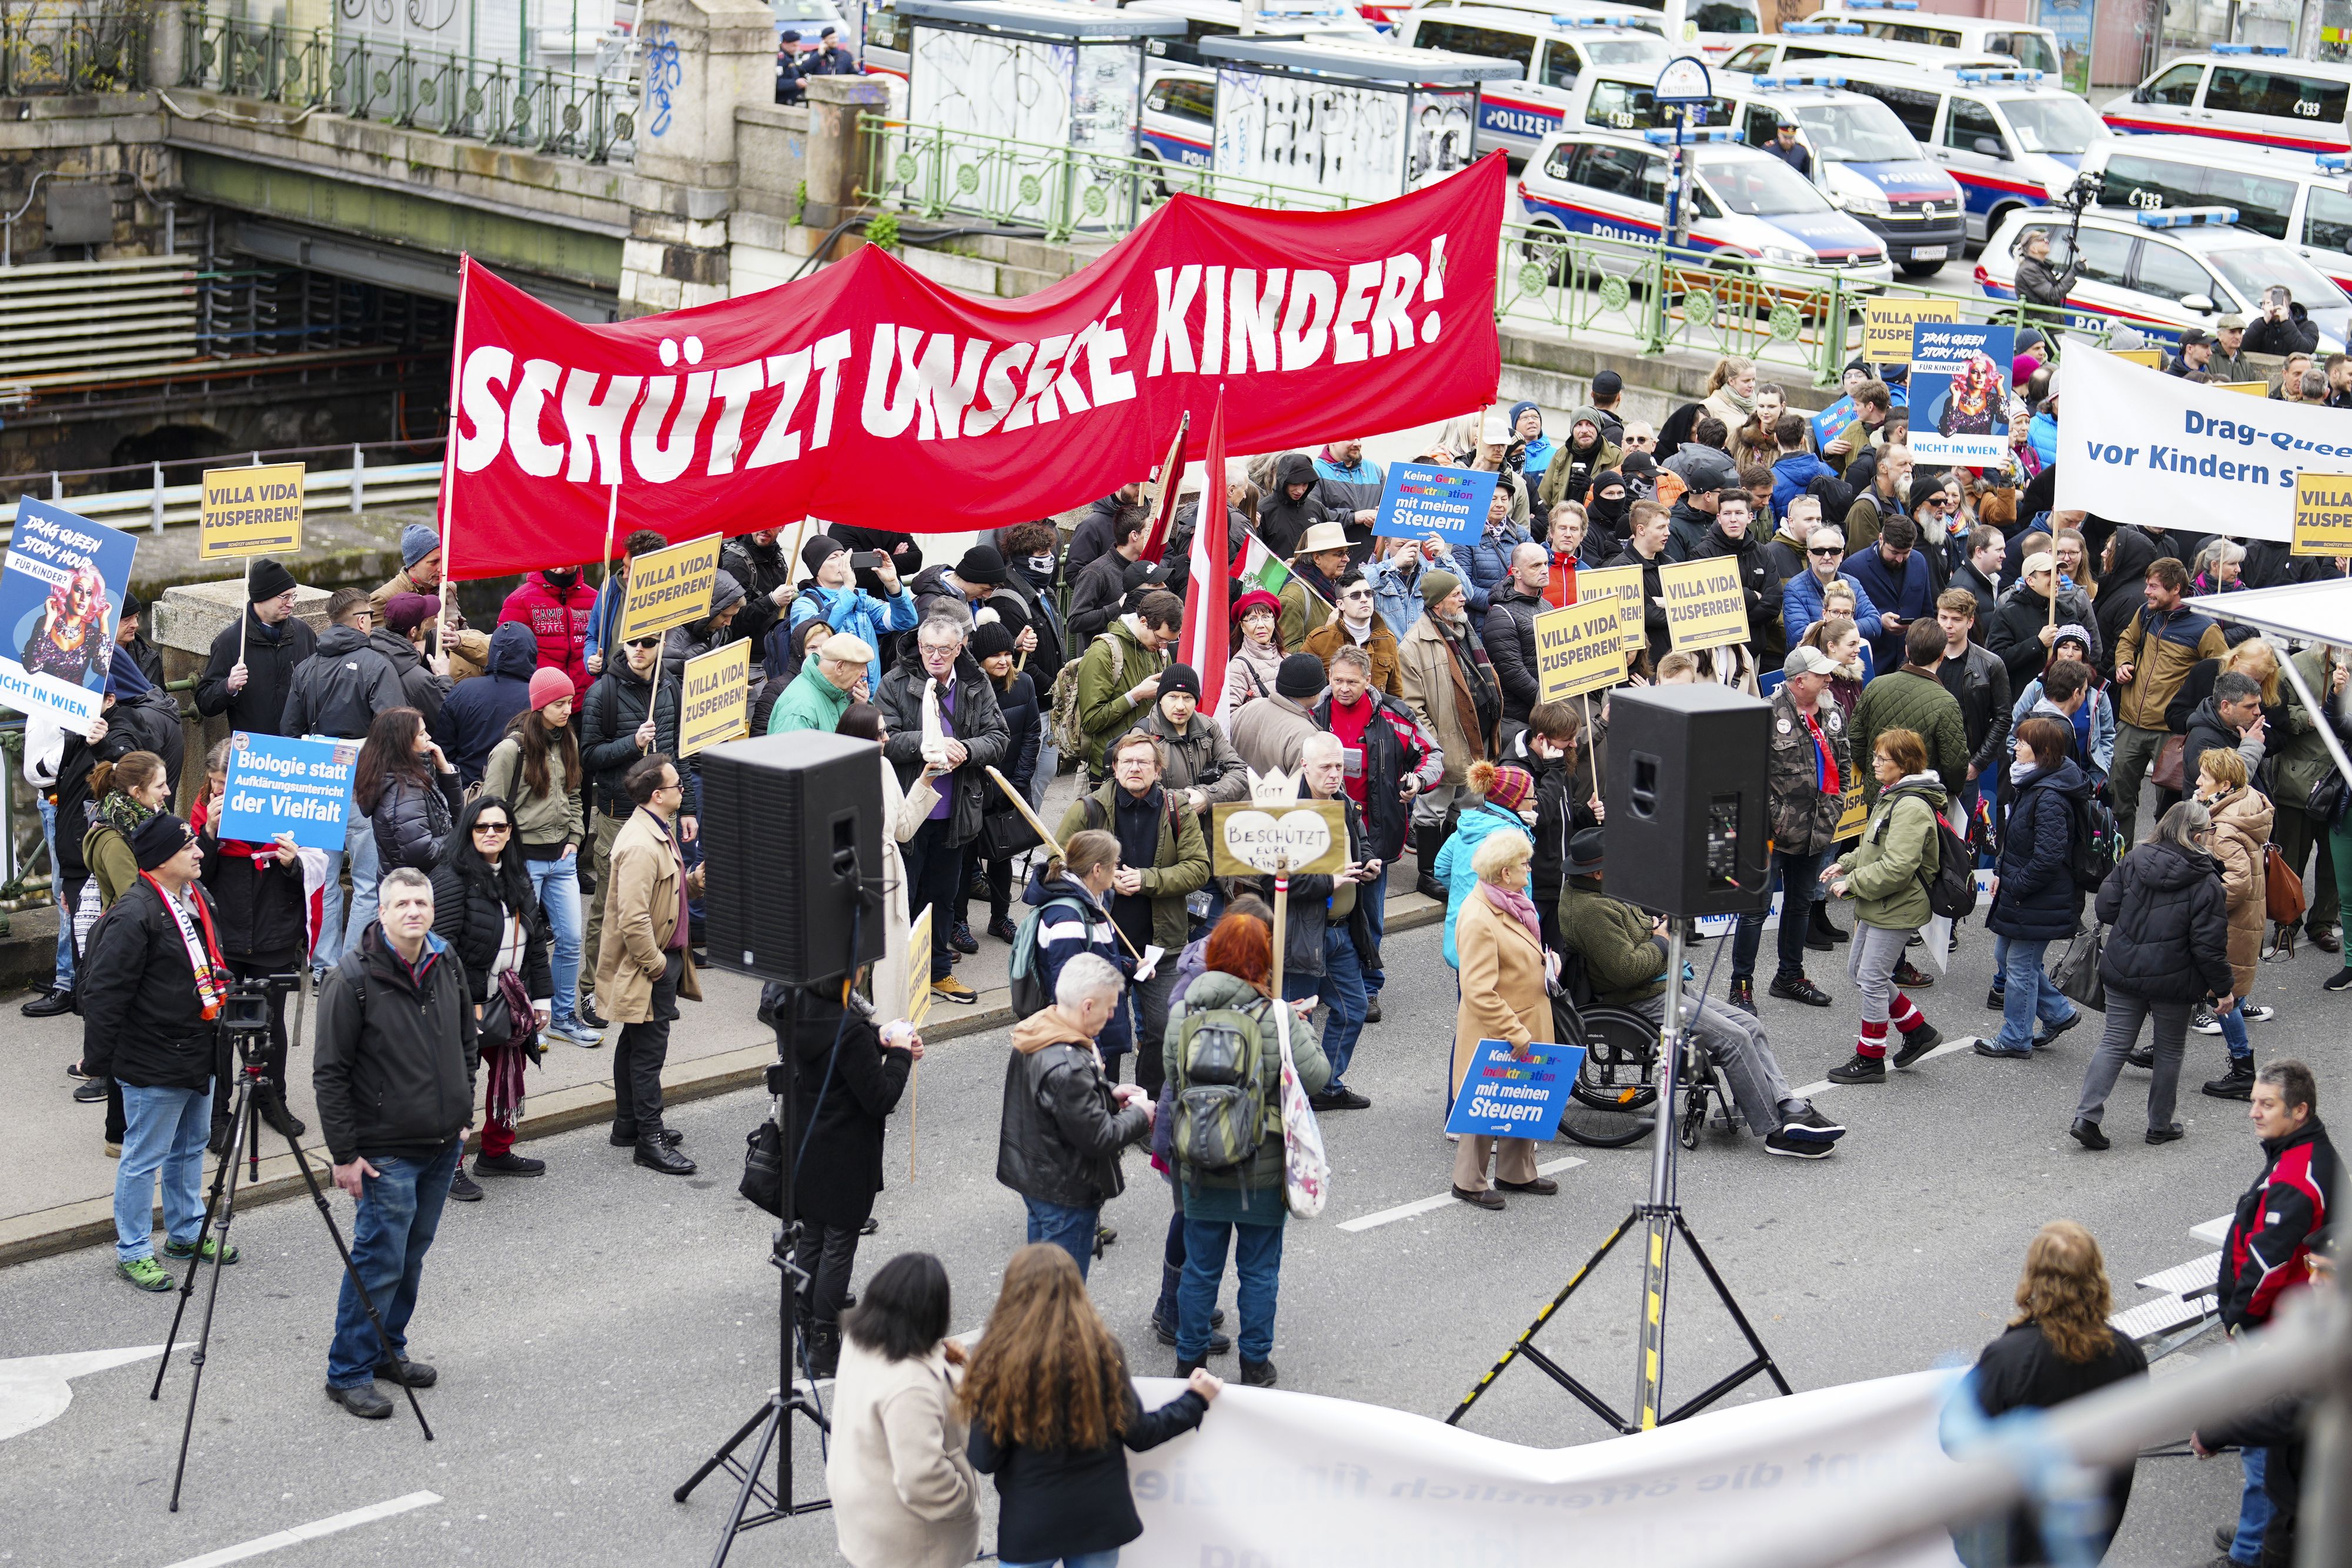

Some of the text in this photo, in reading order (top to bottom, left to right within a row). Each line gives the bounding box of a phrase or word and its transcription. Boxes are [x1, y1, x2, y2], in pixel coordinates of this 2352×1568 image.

[2303, 101, 2321, 117] 133
[1877, 173, 1937, 184] POLIZEI
[2140, 192, 2163, 210] 133
[1872, 312, 1952, 324] VILLA VIDA
[1919, 332, 1987, 347] DRAG QUEEN
[457, 233, 1447, 485] SCHÜTZT UNSERE KINDER!
[1918, 347, 1983, 359] STORY HOUR
[1820, 412, 1838, 427] Keine
[1915, 443, 2000, 456] NICHT IN WIEN.
[2087, 440, 2139, 466] vor
[2149, 444, 2269, 485] Kindern
[1403, 470, 1476, 486] Keine Gender-
[209, 483, 298, 505] VILLA VIDA
[1400, 484, 1473, 500] Indoktrination
[2301, 491, 2352, 507] VILLA
[1395, 497, 1469, 514] mit meinen
[205, 506, 298, 528] ZUSPERREN!
[1392, 509, 1466, 531] Steuern
[22, 515, 103, 554] DRAG QUEEN
[16, 535, 93, 569] STORY HOUR
[15, 558, 67, 584] FÜR KINDER?
[636, 554, 713, 590] VILLA VIDA
[629, 574, 712, 611] ZUSPERREN!
[1615, 584, 1640, 601] VIDA
[1668, 574, 1738, 600] VILLA VIDA
[532, 607, 564, 621] CAMP
[1671, 597, 1742, 622] ZUSPERREN!
[535, 625, 564, 633] SPACE
[1541, 614, 1618, 649] VILLA VIDA
[1542, 636, 1622, 672] ZUSPERREN!
[689, 661, 744, 697] VILLA VIDA
[33, 687, 48, 702] IN
[51, 693, 89, 718] WIEN.
[686, 686, 744, 723] ZUSPERREN!
[238, 751, 348, 780] Biologie statt
[235, 774, 344, 797] Aufklärungsunterricht
[231, 790, 341, 823] der Vielfalt
[1167, 793, 1175, 811] Canon
[1228, 824, 1325, 847] BESCHÜTZT
[1257, 846, 1288, 854] EURE
[1482, 1066, 1556, 1082] Indoktrination
[1475, 1082, 1550, 1101] mit meinen
[1468, 1097, 1544, 1122] Steuern
